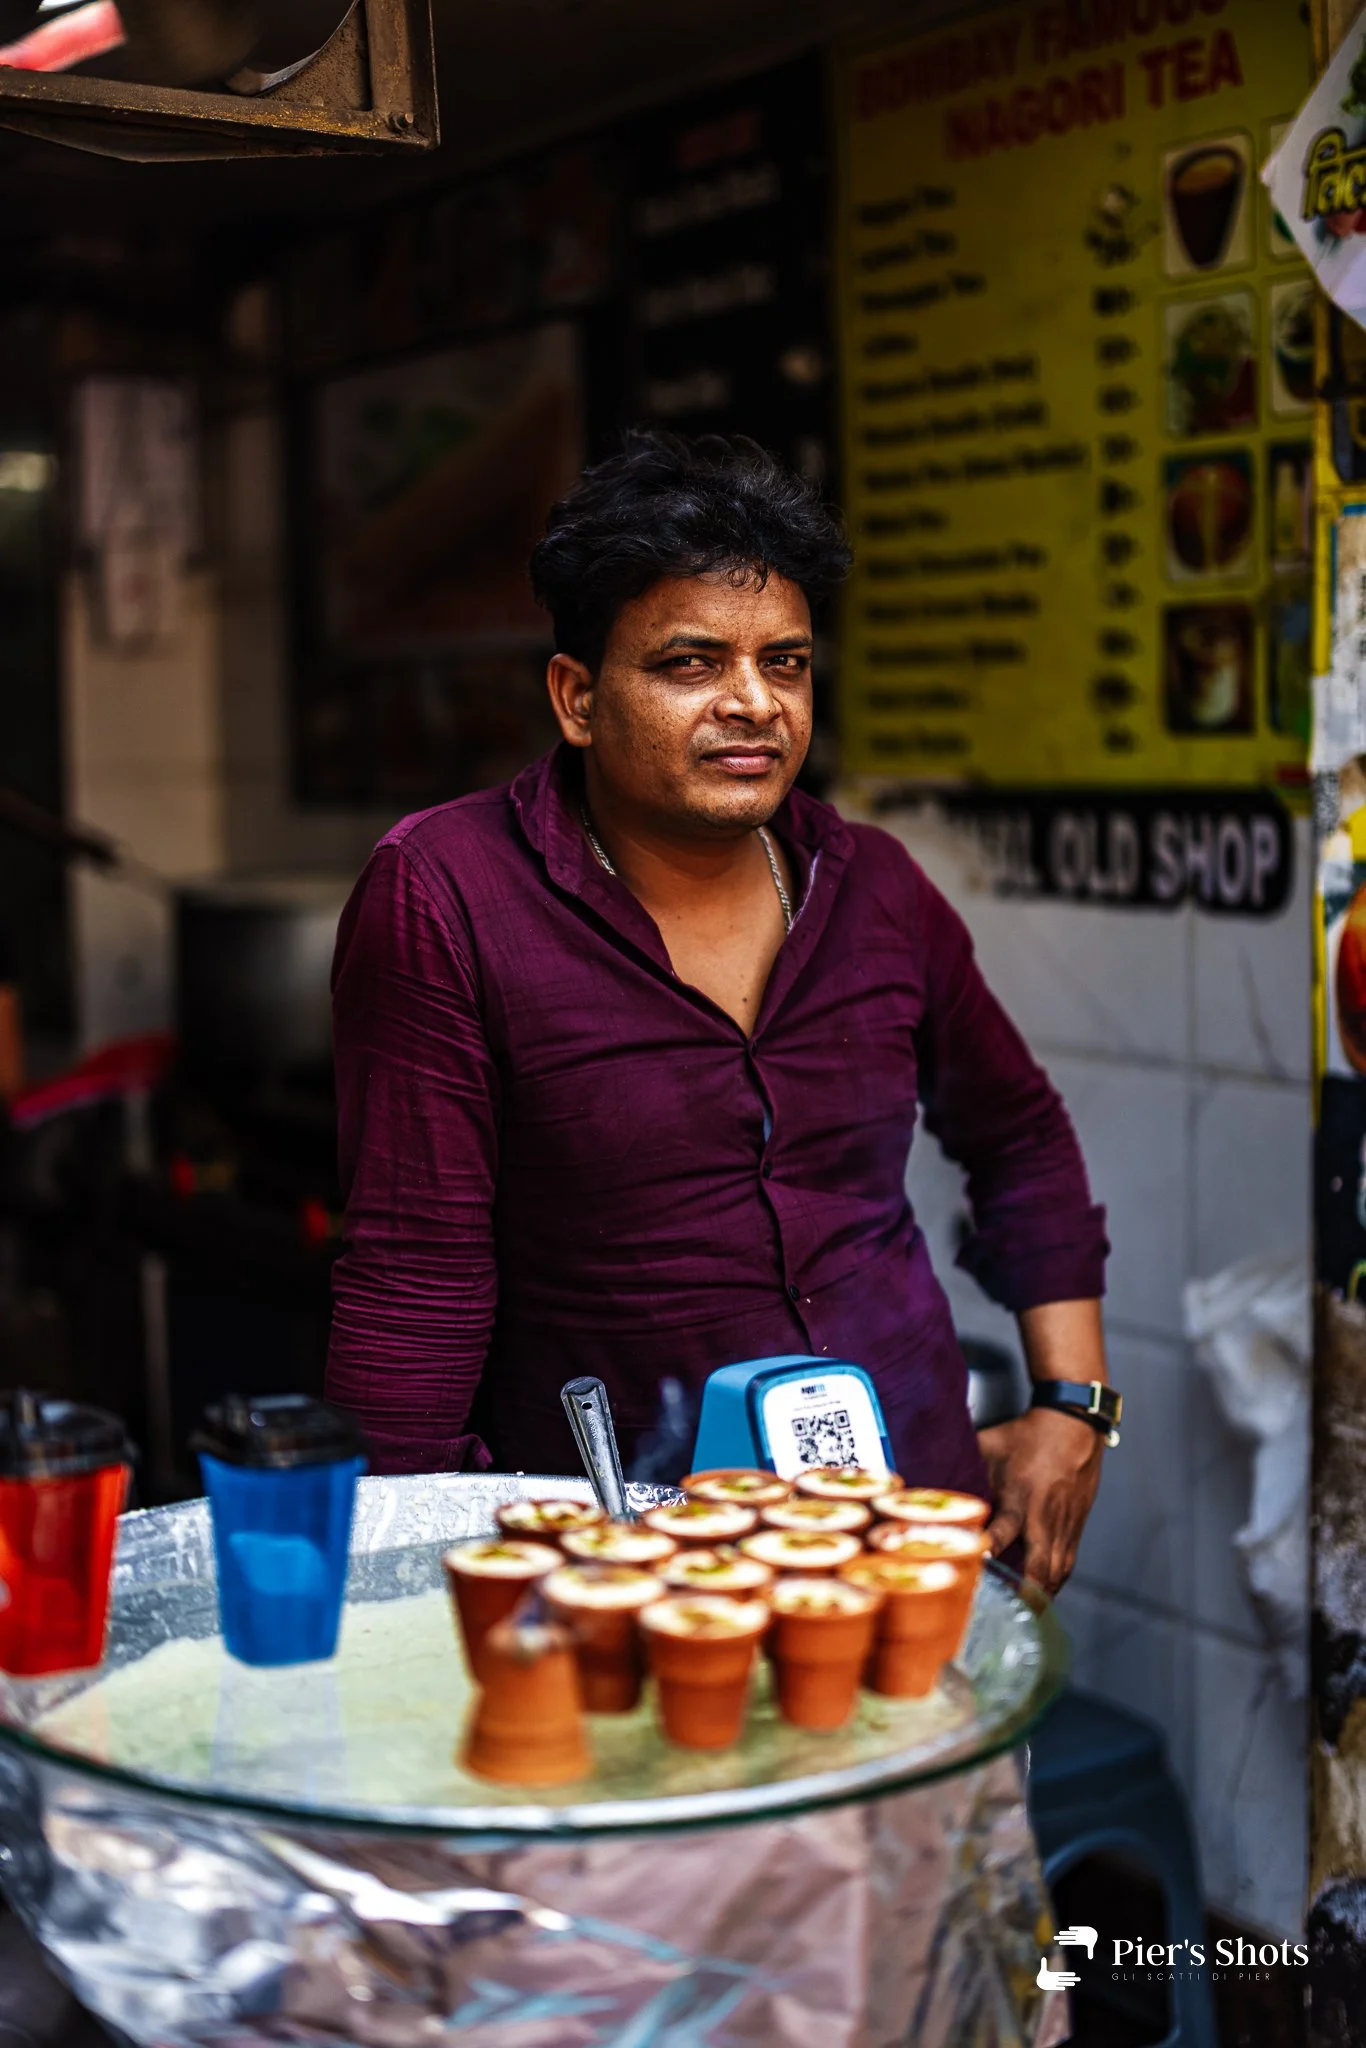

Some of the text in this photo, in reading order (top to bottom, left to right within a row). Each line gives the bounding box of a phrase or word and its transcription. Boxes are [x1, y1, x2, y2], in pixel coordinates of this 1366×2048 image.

[1139, 29, 1244, 107] TEA
[1051, 810, 1140, 895] OLD
[1152, 810, 1281, 908] SHOP
